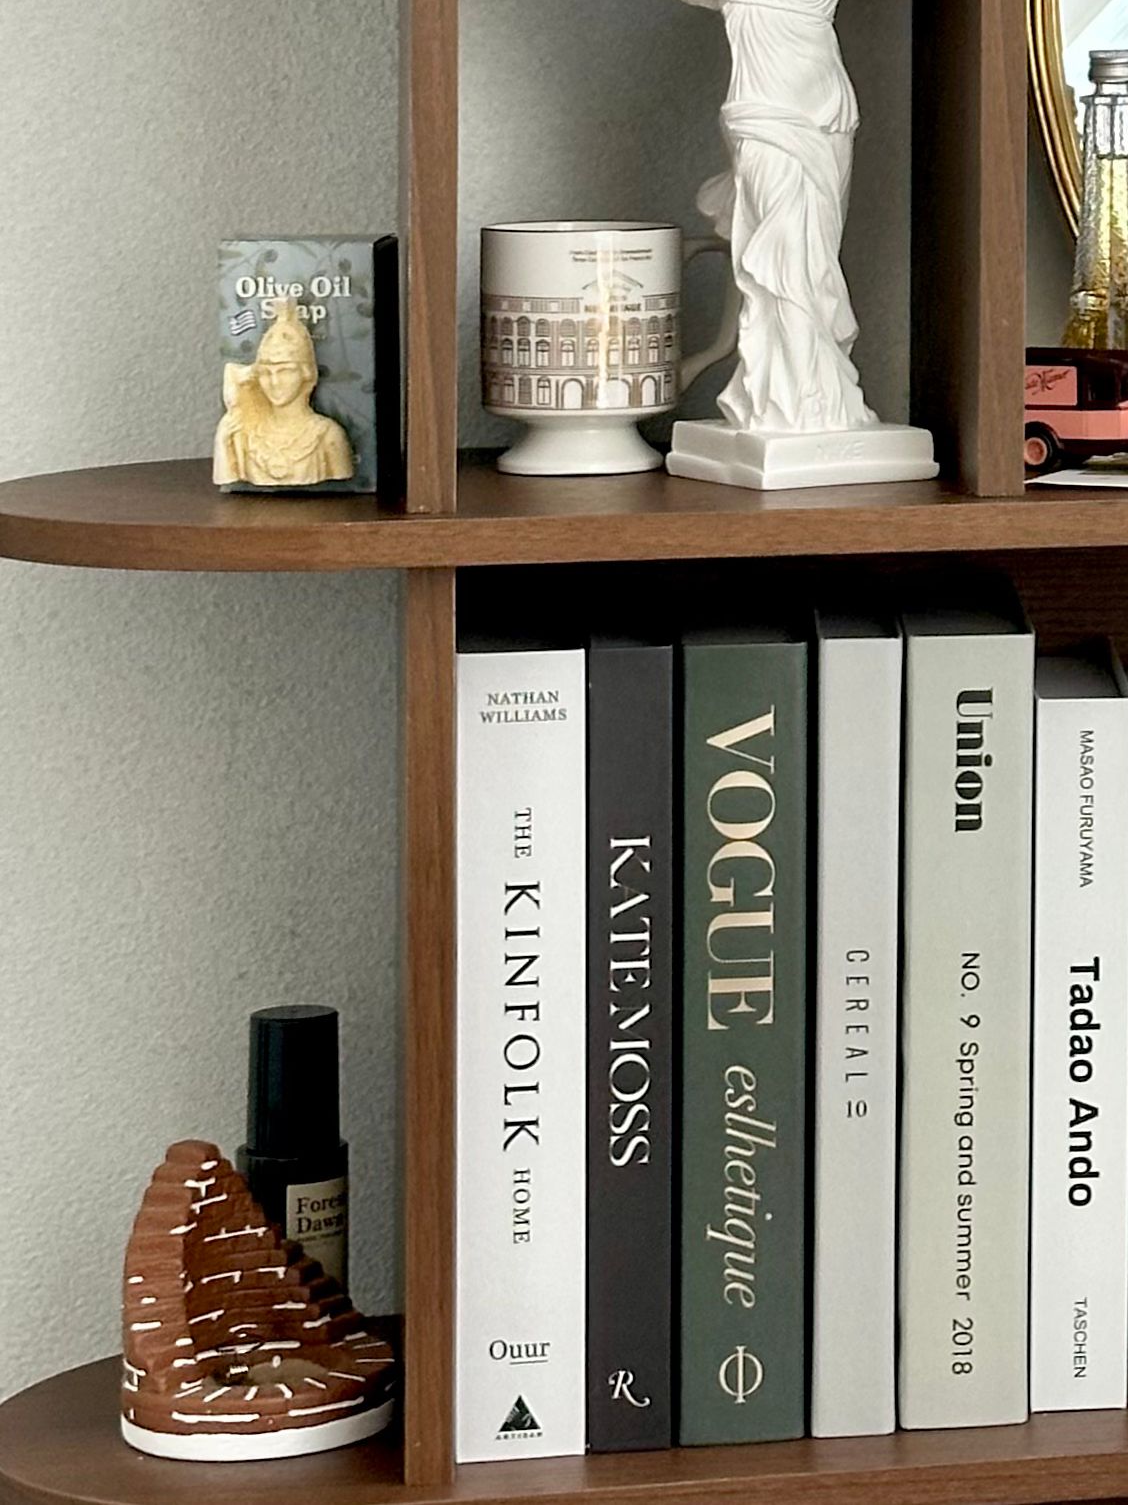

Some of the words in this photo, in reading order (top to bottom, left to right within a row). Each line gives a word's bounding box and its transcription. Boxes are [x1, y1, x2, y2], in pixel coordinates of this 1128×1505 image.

[235, 276, 304, 299] Olive
[309, 276, 353, 298] Oil
[260, 298, 327, 324] Sap
[480, 709, 566, 723] WILLIAMS
[488, 691, 558, 705] NATHAN
[955, 689, 992, 832] Union
[1080, 731, 1094, 789] MASAO
[515, 808, 531, 858] THE
[707, 705, 775, 1029] VOGUE
[1080, 795, 1093, 887] FURUYAMA
[610, 837, 650, 991] KATE
[961, 953, 980, 997] NO.
[503, 882, 540, 1151] KINFOLK
[846, 950, 869, 1082] CEREAL
[960, 1015, 980, 1028] 9
[1069, 957, 1101, 1082] Tadao
[610, 1003, 649, 1166] MOSS
[848, 1101, 867, 1117] 10
[954, 1043, 979, 1126] Spring
[958, 1136, 976, 1185] and
[1069, 1098, 1100, 1206] Ando
[513, 1170, 530, 1243] HOME
[957, 1195, 972, 1300] summer
[488, 1339, 551, 1360] Ouur
[952, 1318, 973, 1374] 2018
[1074, 1298, 1087, 1377] TASCHEN
